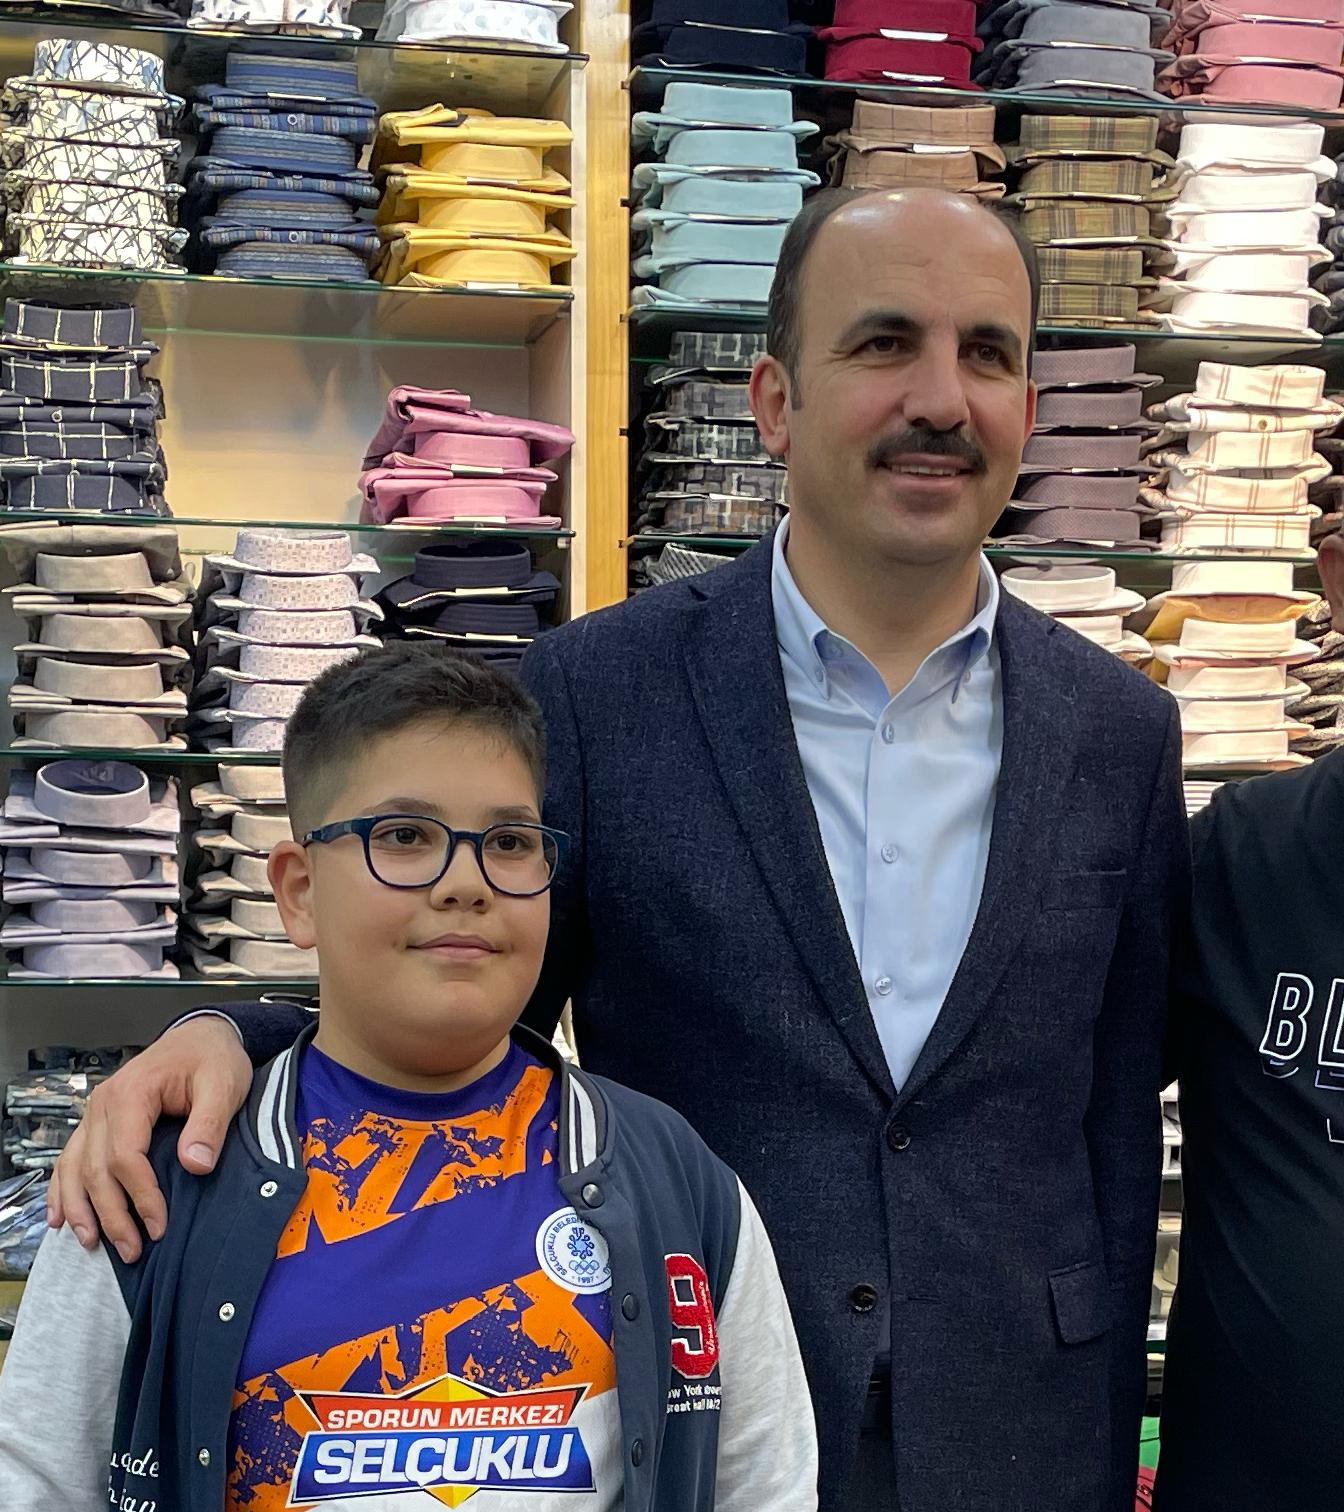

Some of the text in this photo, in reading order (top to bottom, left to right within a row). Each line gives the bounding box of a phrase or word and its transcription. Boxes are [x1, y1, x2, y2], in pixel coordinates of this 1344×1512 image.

[664, 1253, 720, 1380] 9
[327, 1408, 441, 1430] SPORUN
[313, 1432, 575, 1487] SELÇUKLU
